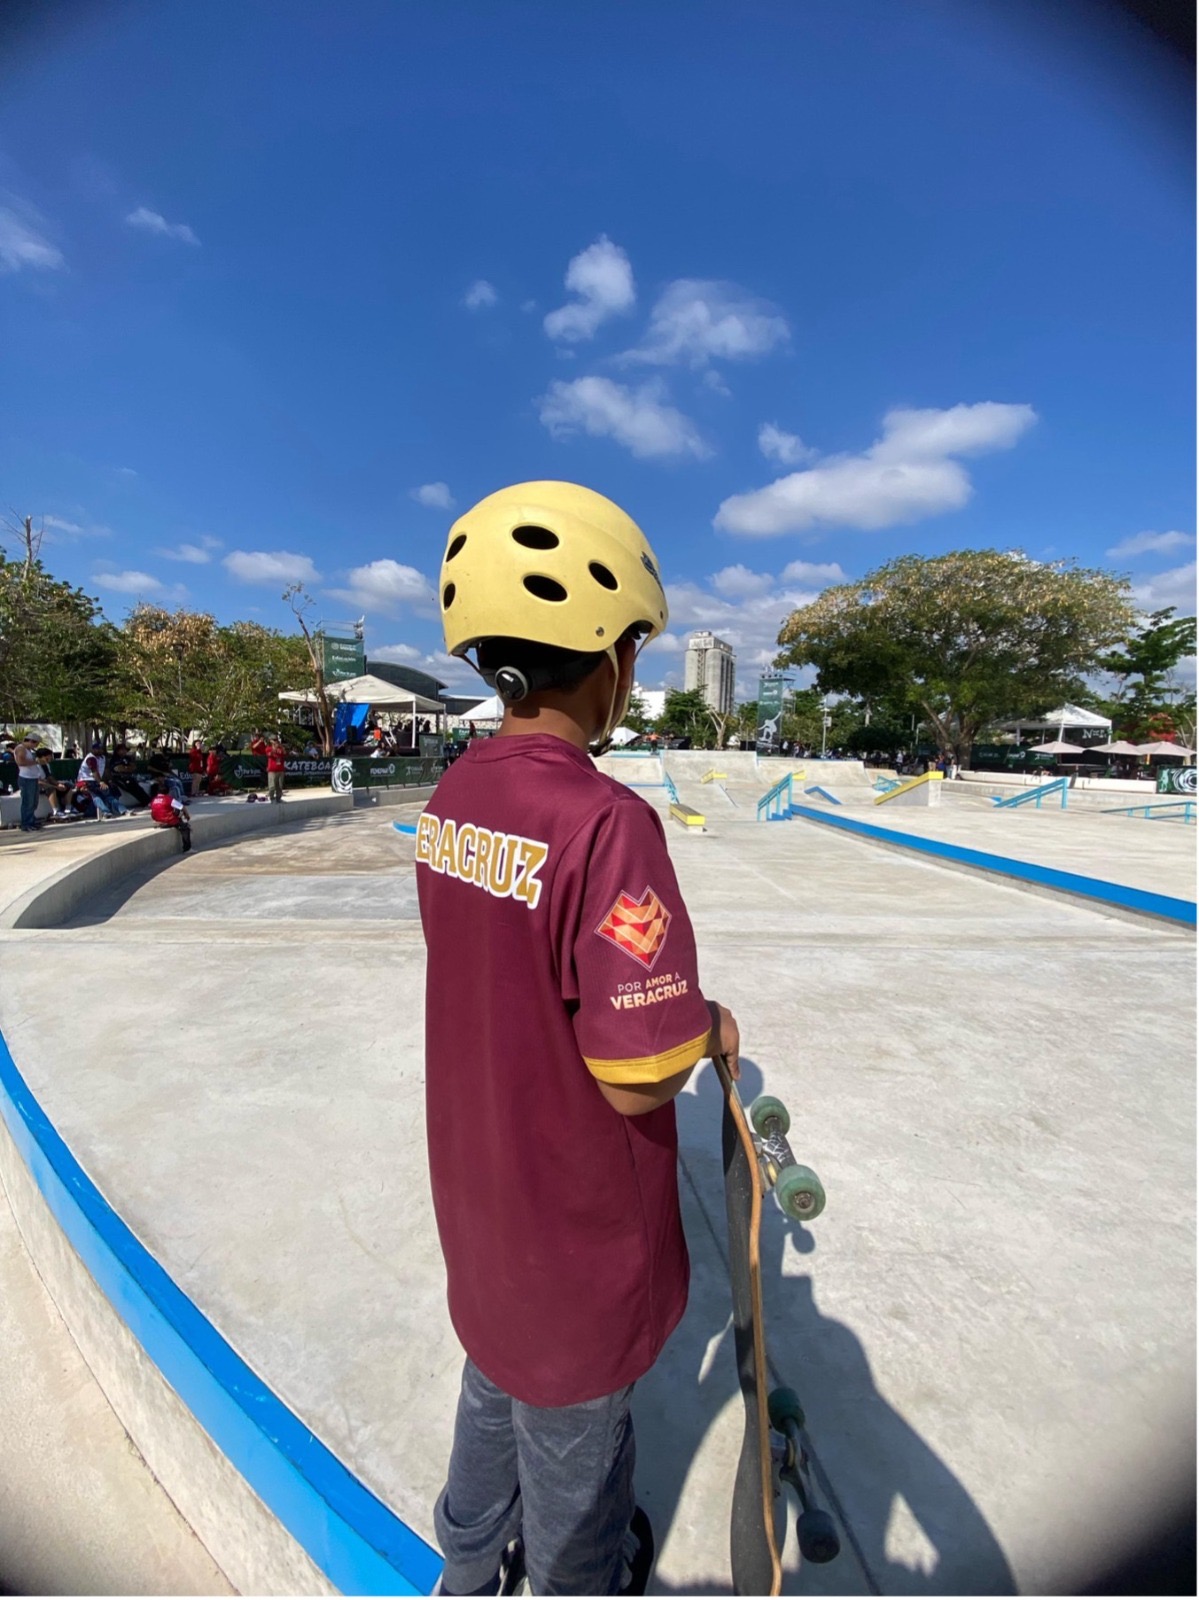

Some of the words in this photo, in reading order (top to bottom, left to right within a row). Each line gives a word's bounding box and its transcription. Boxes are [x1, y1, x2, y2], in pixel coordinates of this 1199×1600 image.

[284, 760, 331, 771] KATEBOA
[415, 812, 549, 910] ERACRUZ
[609, 979, 689, 1010] VERACRUZ
[617, 981, 642, 993] POR
[645, 973, 673, 990] AMOR
[674, 971, 681, 981] A
